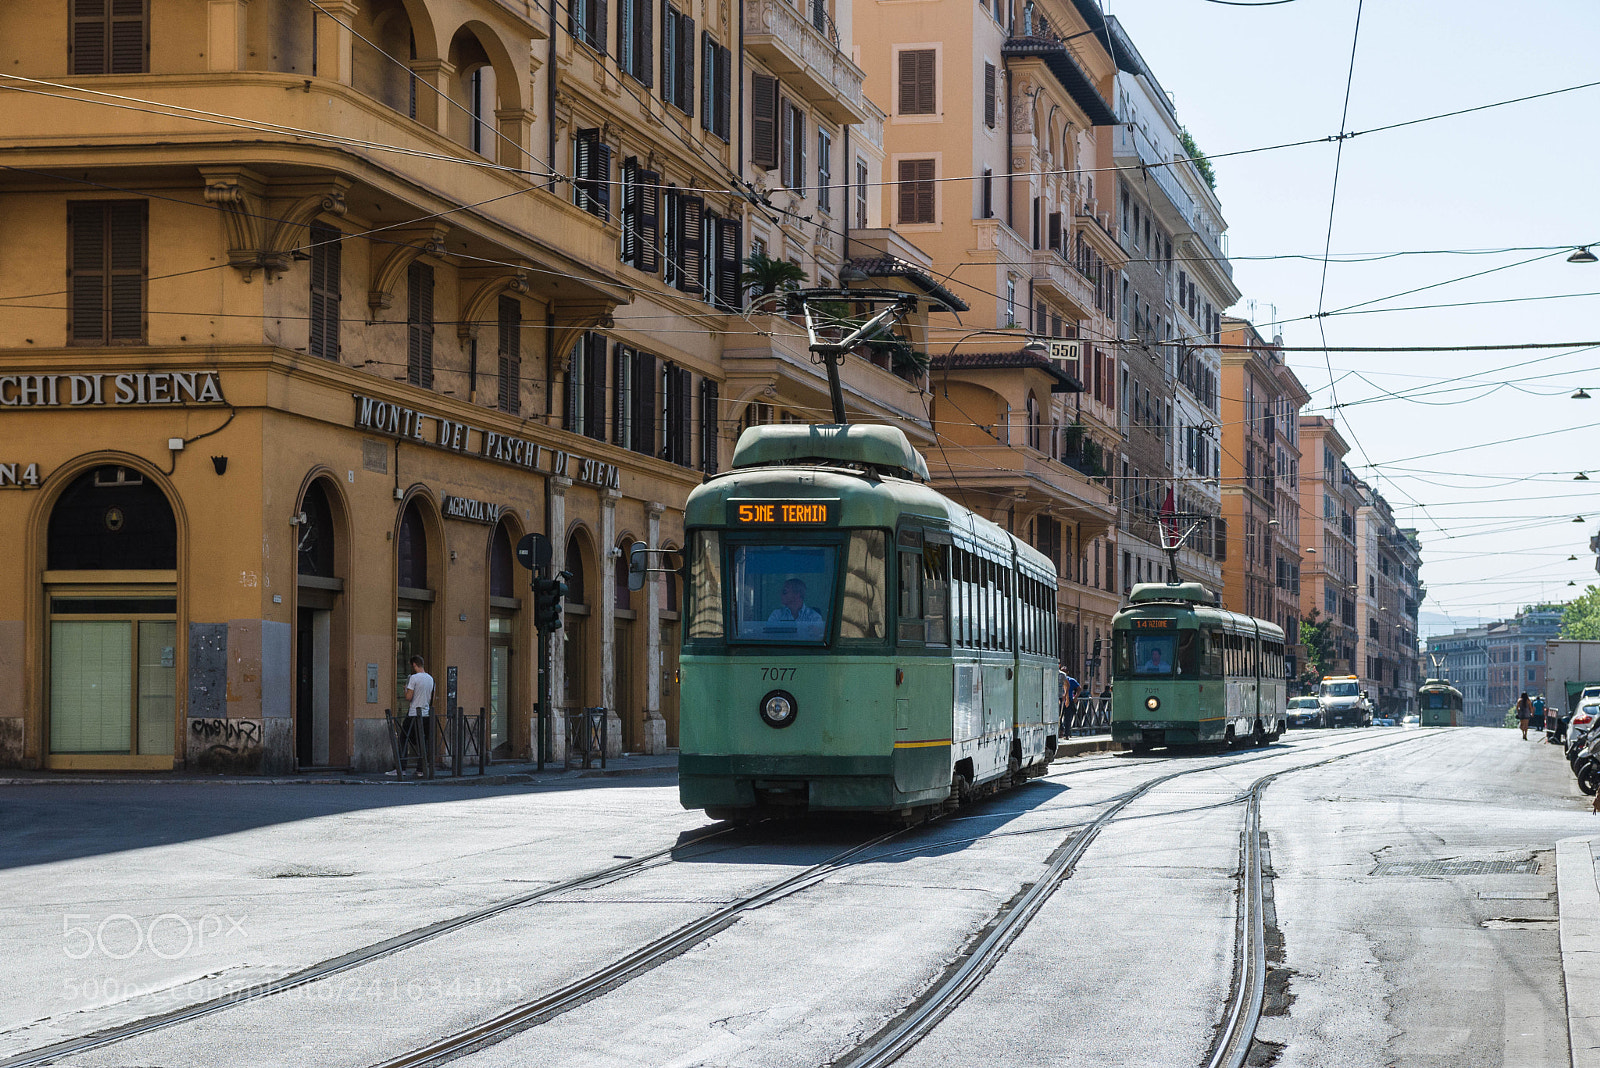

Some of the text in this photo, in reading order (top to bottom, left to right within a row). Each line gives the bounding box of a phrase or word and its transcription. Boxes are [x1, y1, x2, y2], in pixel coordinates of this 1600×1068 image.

[1052, 344, 1078, 358] 550
[0, 373, 223, 406] CHI DI SIENA
[360, 397, 620, 488] MONTE DEI PASCHI DI SIENA
[447, 497, 484, 520] AGENZIA
[781, 504, 827, 522] TERMIN
[1137, 620, 1148, 628] 14
[761, 667, 797, 681] 7077
